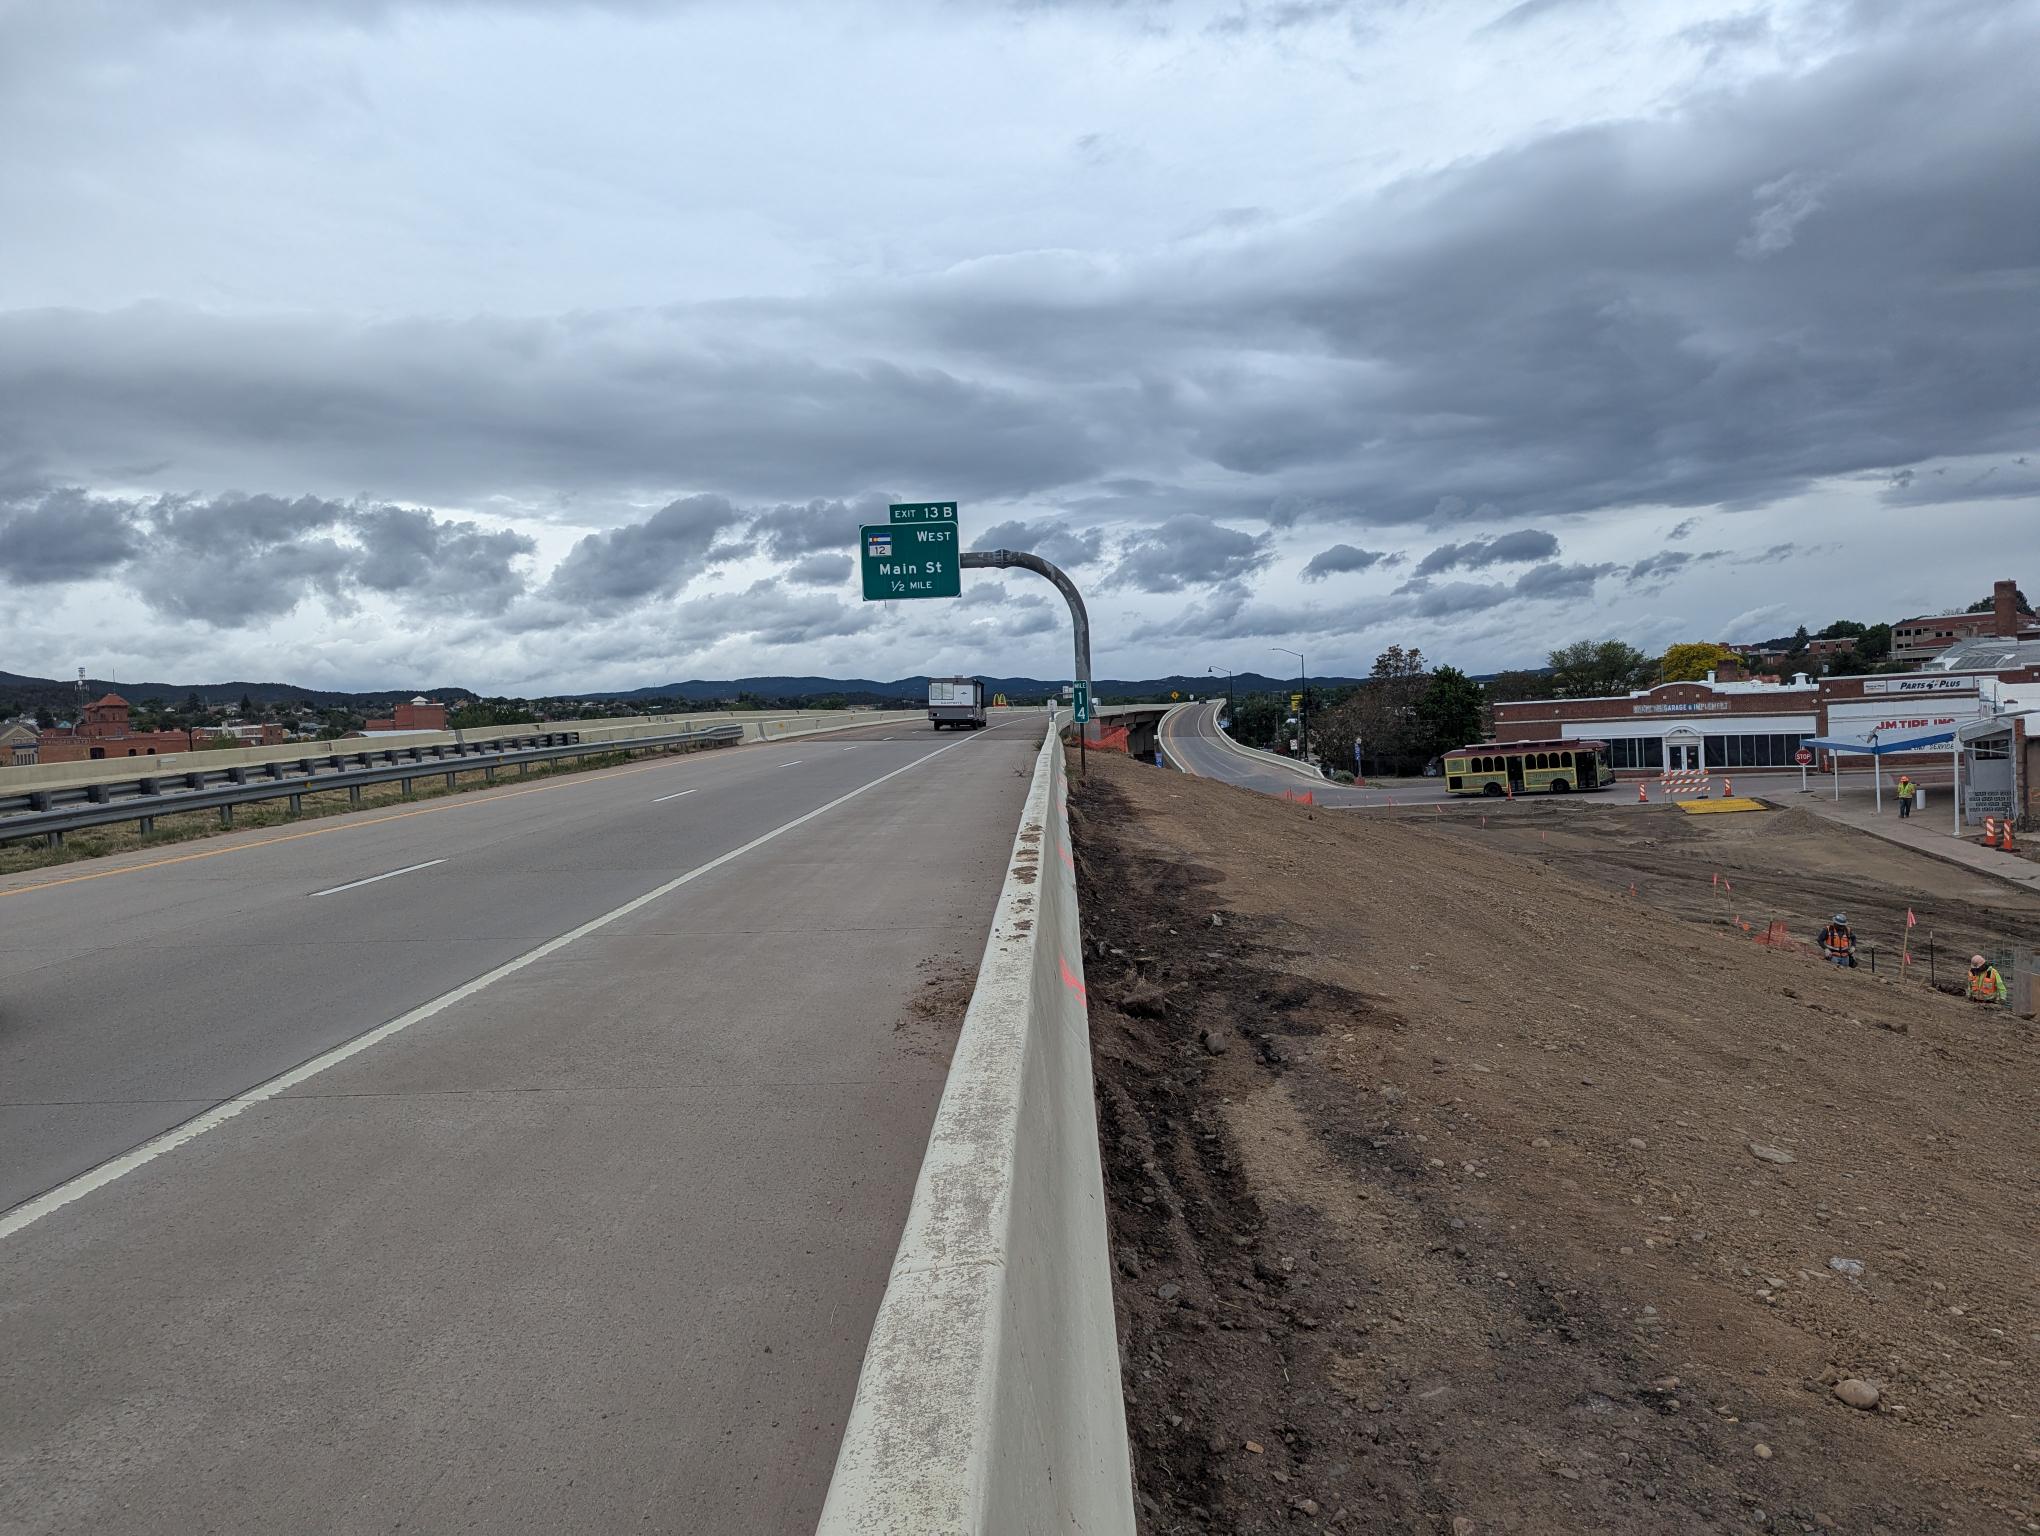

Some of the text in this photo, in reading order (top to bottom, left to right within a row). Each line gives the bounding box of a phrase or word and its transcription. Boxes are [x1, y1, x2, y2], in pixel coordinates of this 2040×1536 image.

[895, 510, 916, 518] EXIT
[917, 531, 951, 542] WEST
[880, 562, 942, 575] Main St
[910, 581, 932, 589] MILE
